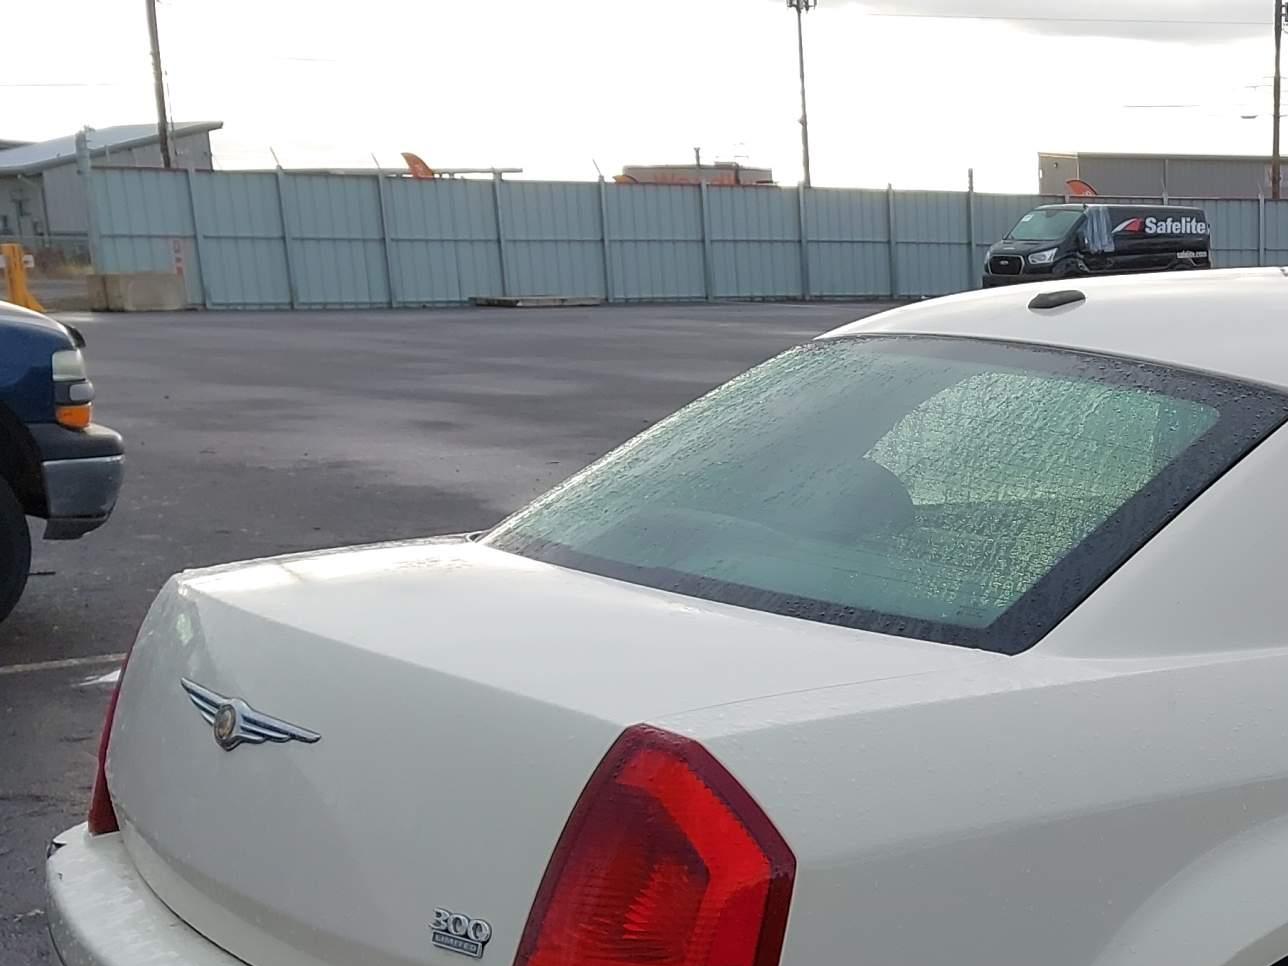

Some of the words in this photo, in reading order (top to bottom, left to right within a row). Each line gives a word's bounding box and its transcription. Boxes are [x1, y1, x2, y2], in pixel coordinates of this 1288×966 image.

[1144, 216, 1206, 234] Safelite
[429, 907, 492, 942] 300
[434, 933, 478, 953] LIMITED
